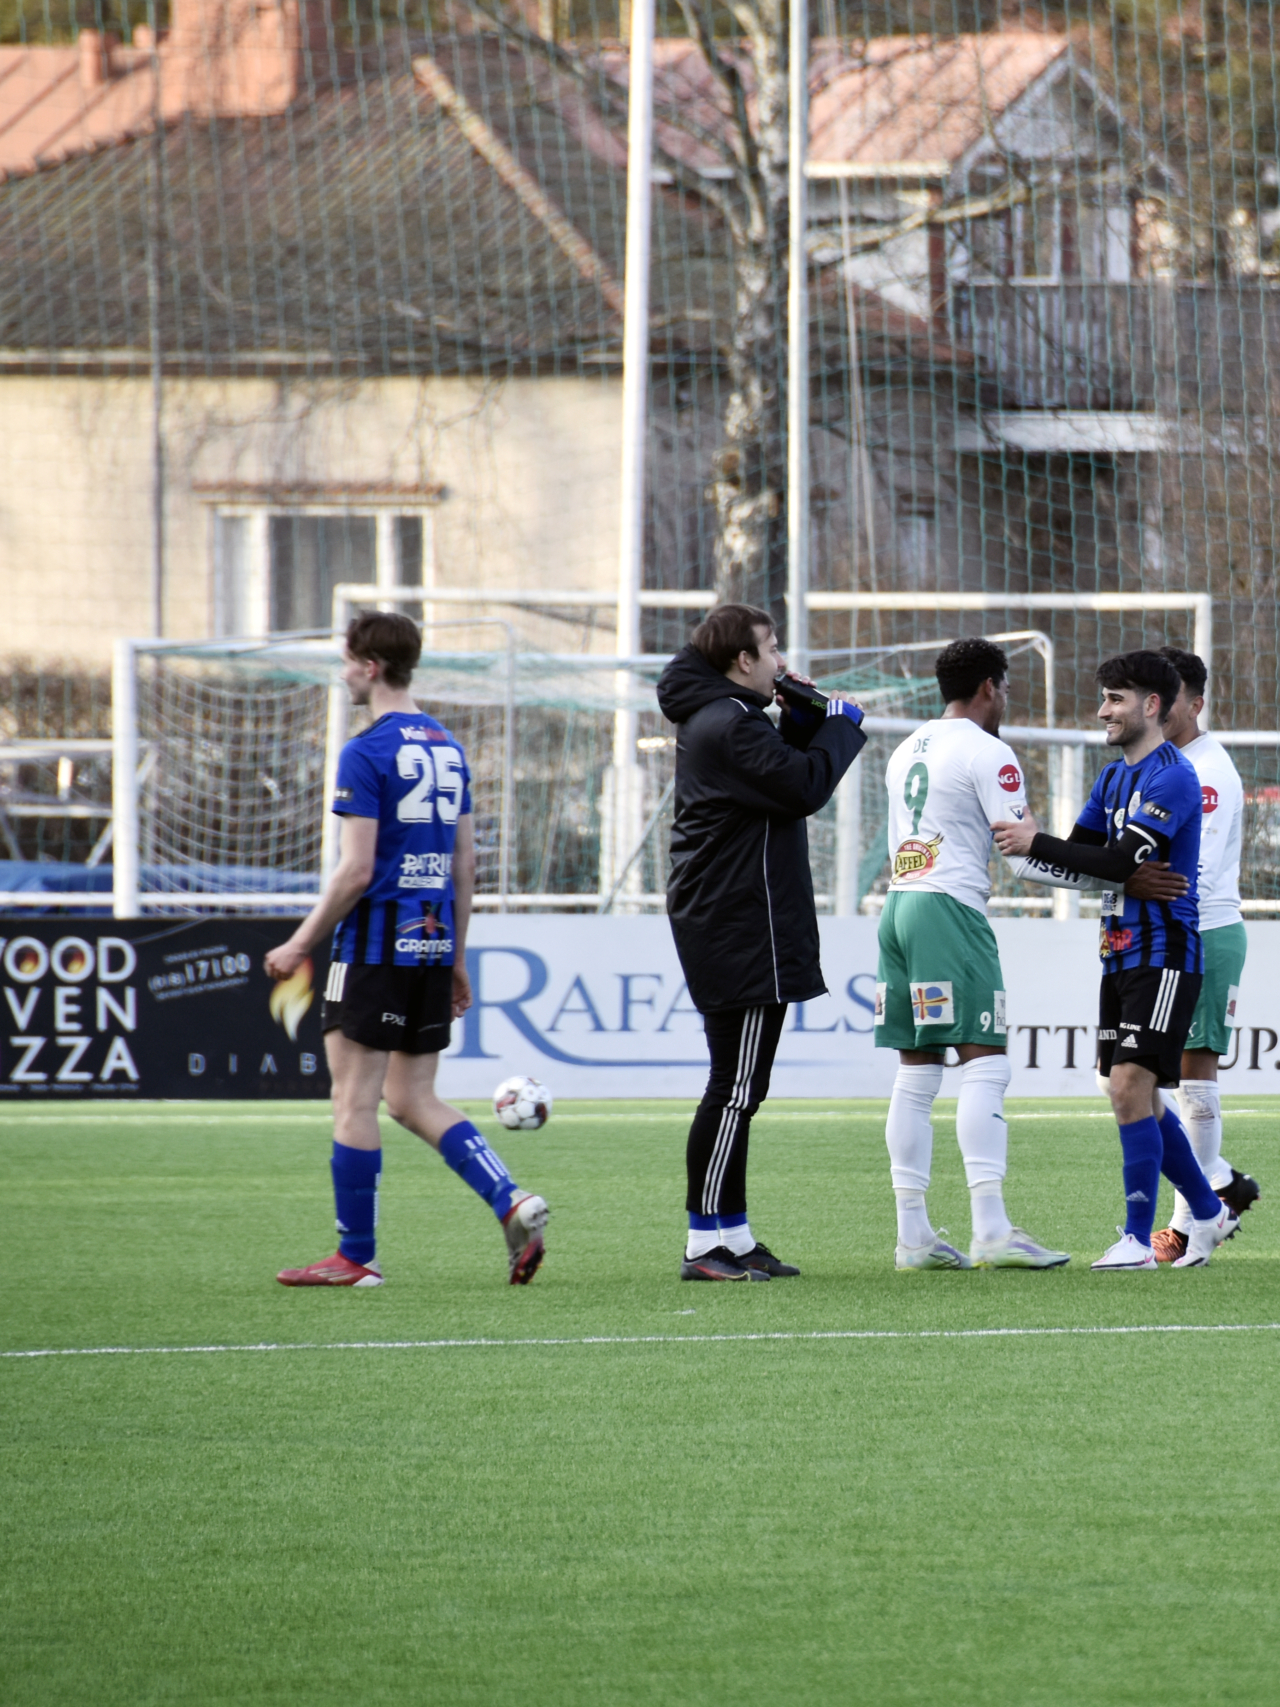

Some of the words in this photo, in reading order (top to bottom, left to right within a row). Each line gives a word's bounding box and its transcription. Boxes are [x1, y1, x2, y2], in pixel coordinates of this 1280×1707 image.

[395, 744, 462, 825] 25
[903, 762, 928, 836] 9
[1134, 845, 1154, 864] C
[0, 935, 137, 983] OOD
[3, 986, 137, 1033] VEN
[980, 1011, 991, 1032] 9
[8, 1035, 140, 1082] ZZA
